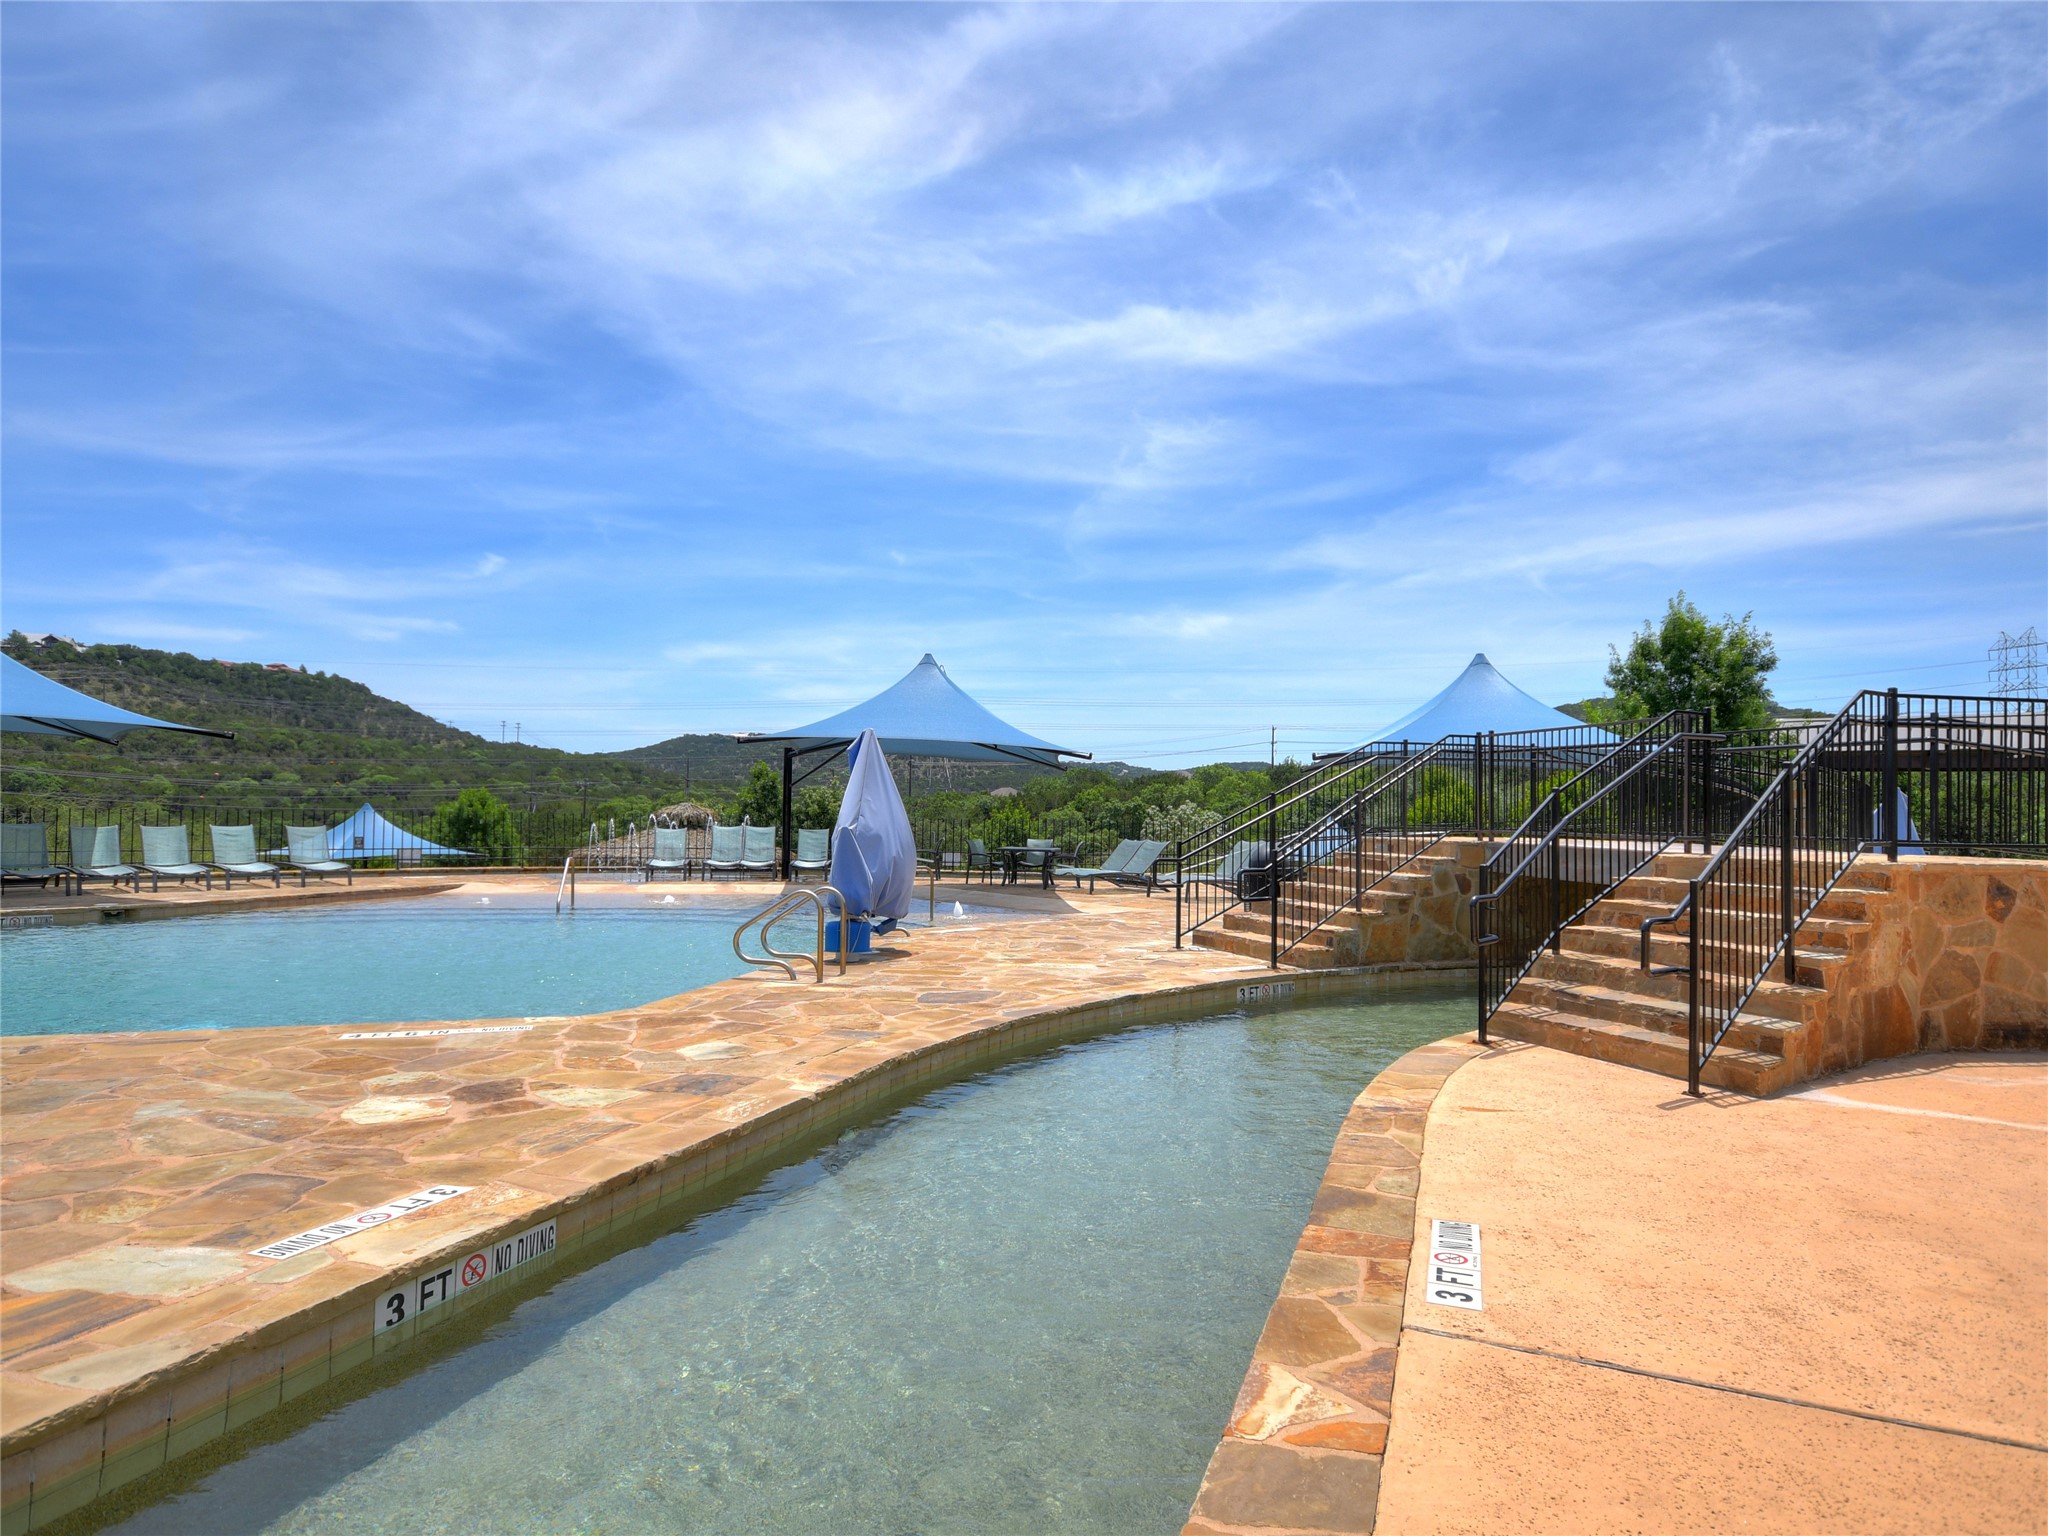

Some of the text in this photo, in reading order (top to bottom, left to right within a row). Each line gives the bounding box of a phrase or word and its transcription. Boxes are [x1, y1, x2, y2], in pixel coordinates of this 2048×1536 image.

[1240, 988, 1246, 998] 3
[1250, 986, 1259, 998] FT
[257, 1188, 458, 1257] 3 FT NO DIVING
[385, 1225, 555, 1327] 3 FT NO DIVING
[1435, 1221, 1474, 1303] 3 FT NO DIVING
